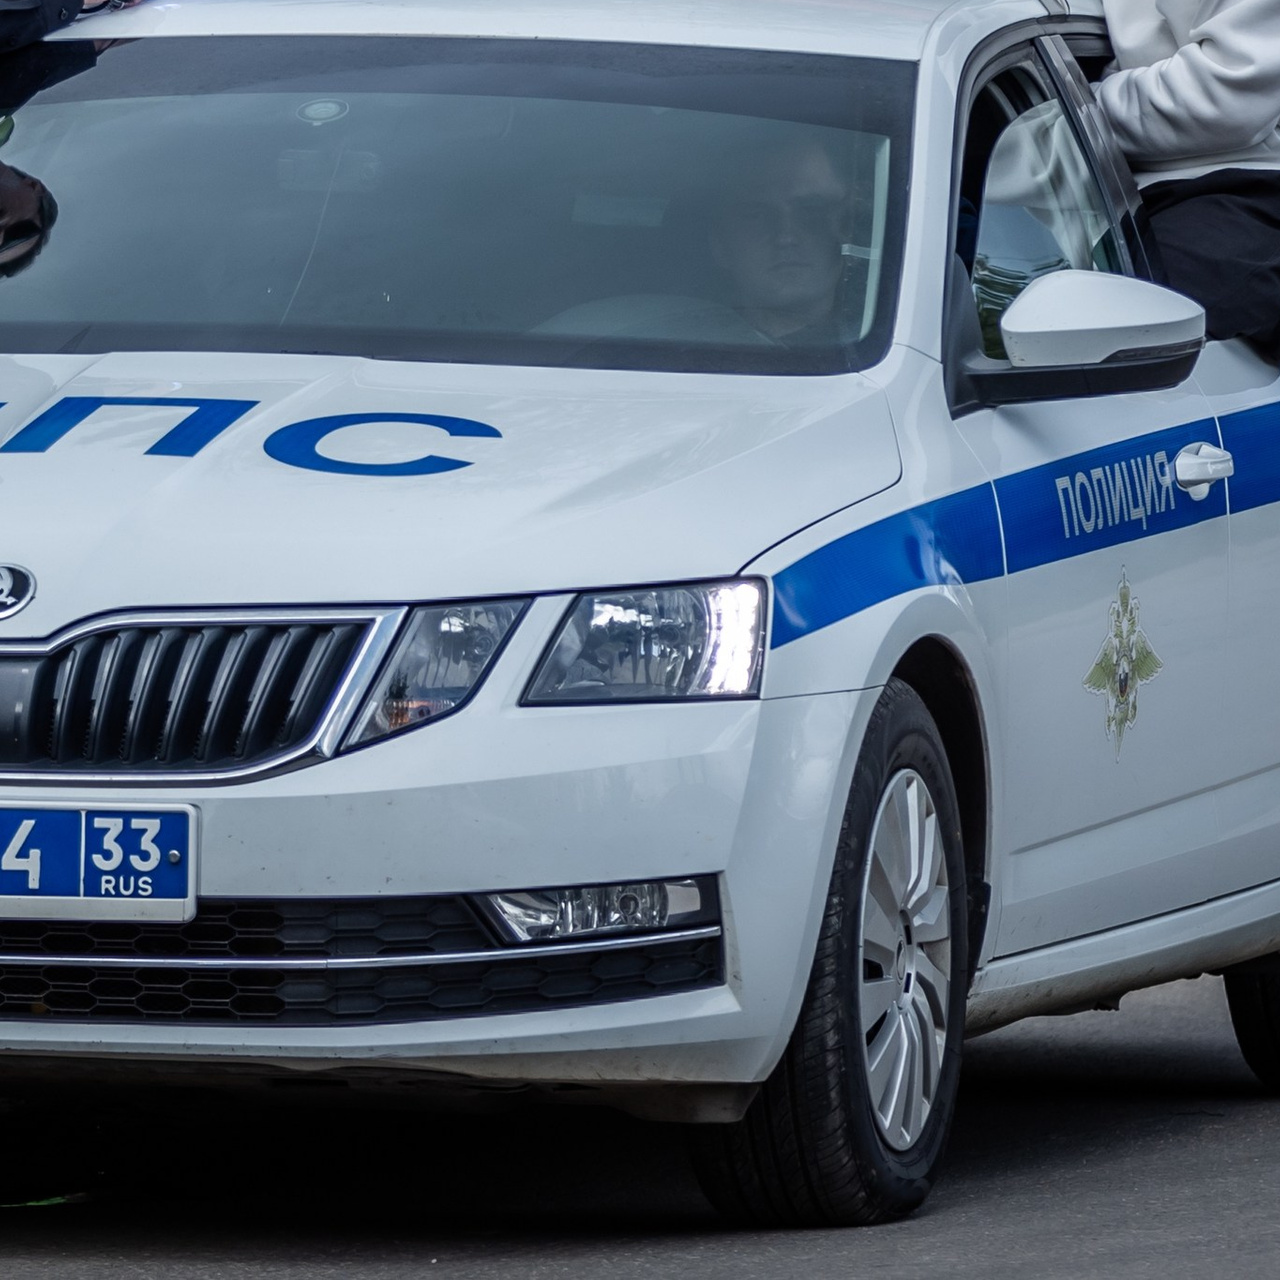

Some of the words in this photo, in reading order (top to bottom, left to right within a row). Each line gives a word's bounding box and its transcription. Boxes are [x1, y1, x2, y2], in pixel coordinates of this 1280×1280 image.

[1055, 451, 1175, 538] ПОЛИЦИЯ
[91, 817, 161, 872] 33
[100, 875, 153, 897] RUS
